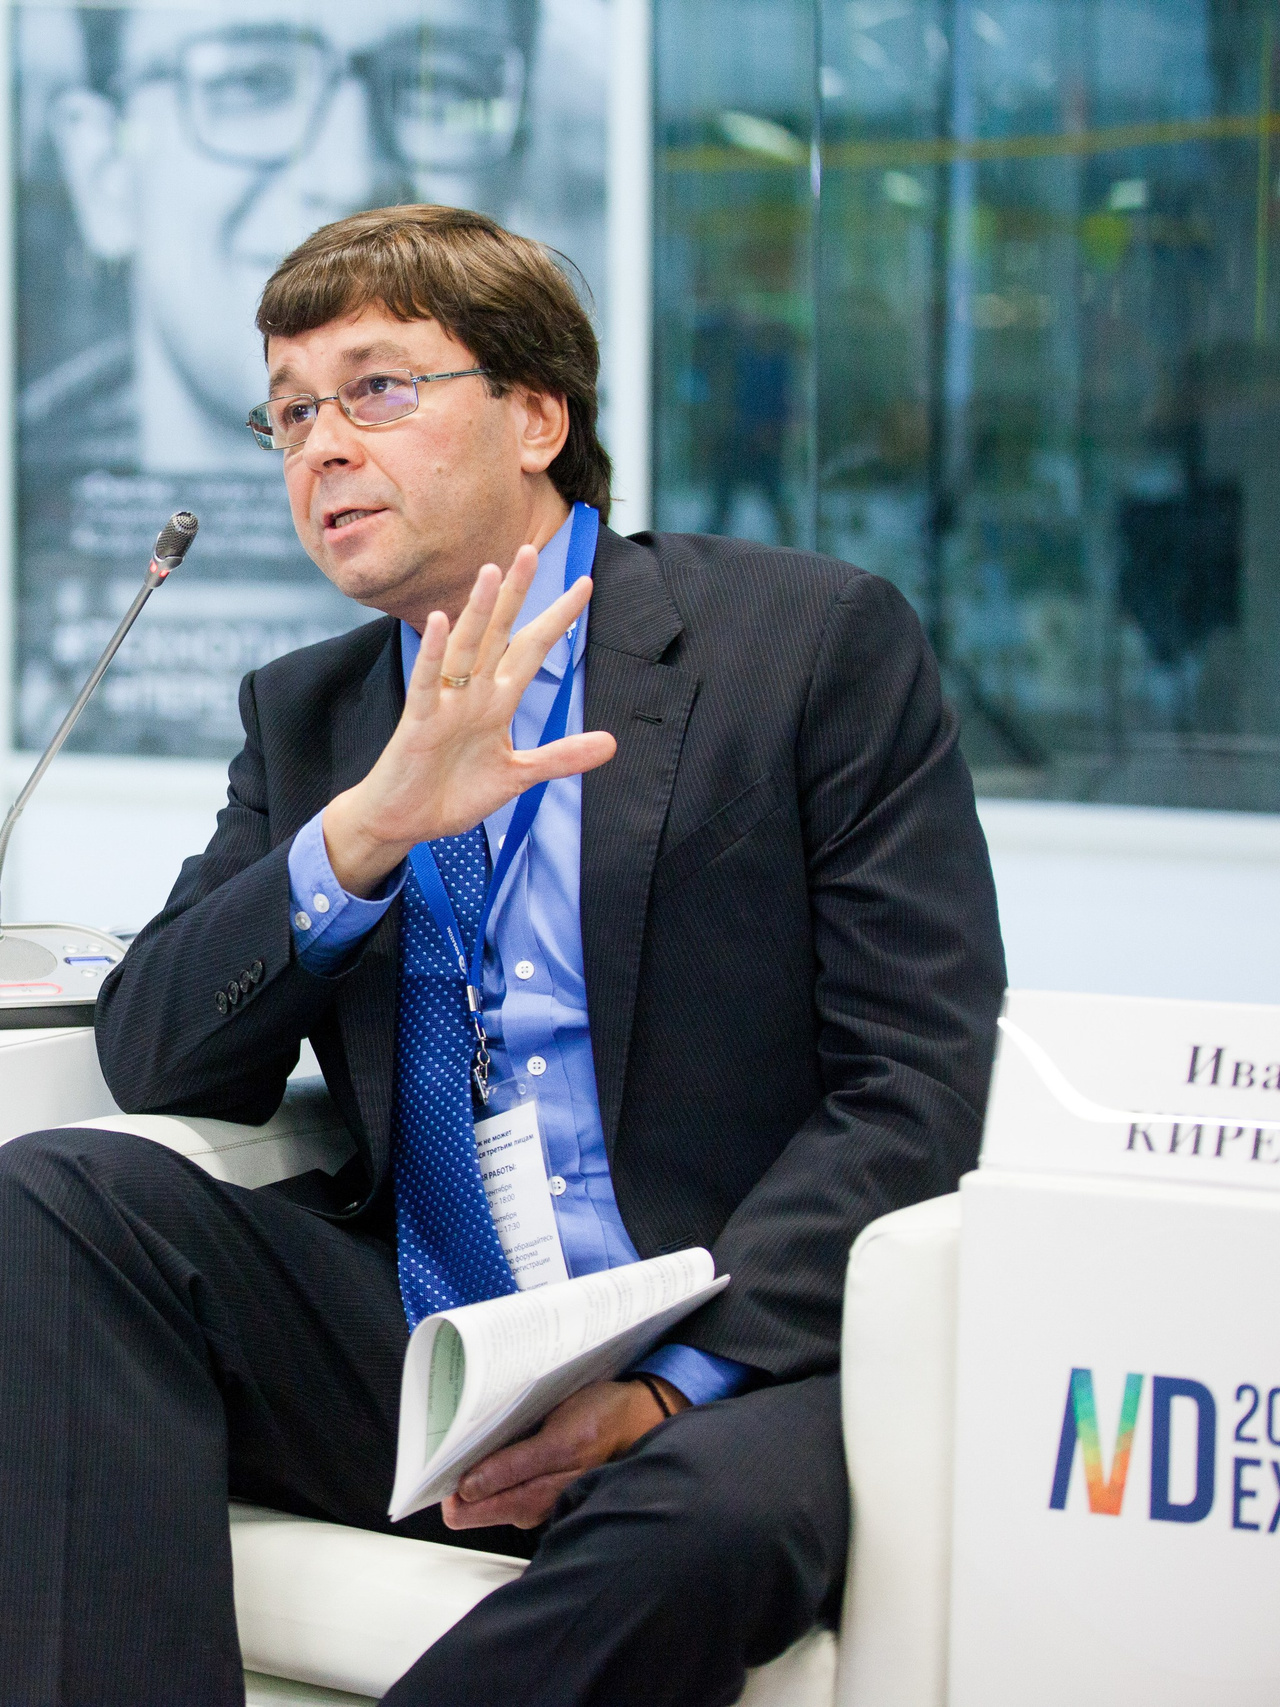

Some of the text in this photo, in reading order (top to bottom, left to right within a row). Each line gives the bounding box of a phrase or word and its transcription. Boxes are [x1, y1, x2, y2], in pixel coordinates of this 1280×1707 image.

[1186, 1045, 1280, 1091] Ива
[492, 1130, 512, 1143] может
[487, 1142, 513, 1157] третьим
[489, 1164, 517, 1180] РАБОТЫ:
[504, 1221, 521, 1233] 17:30
[514, 1234, 554, 1254] обращайтесь
[515, 1250, 539, 1265] форума
[1048, 1366, 1217, 1525] ND
